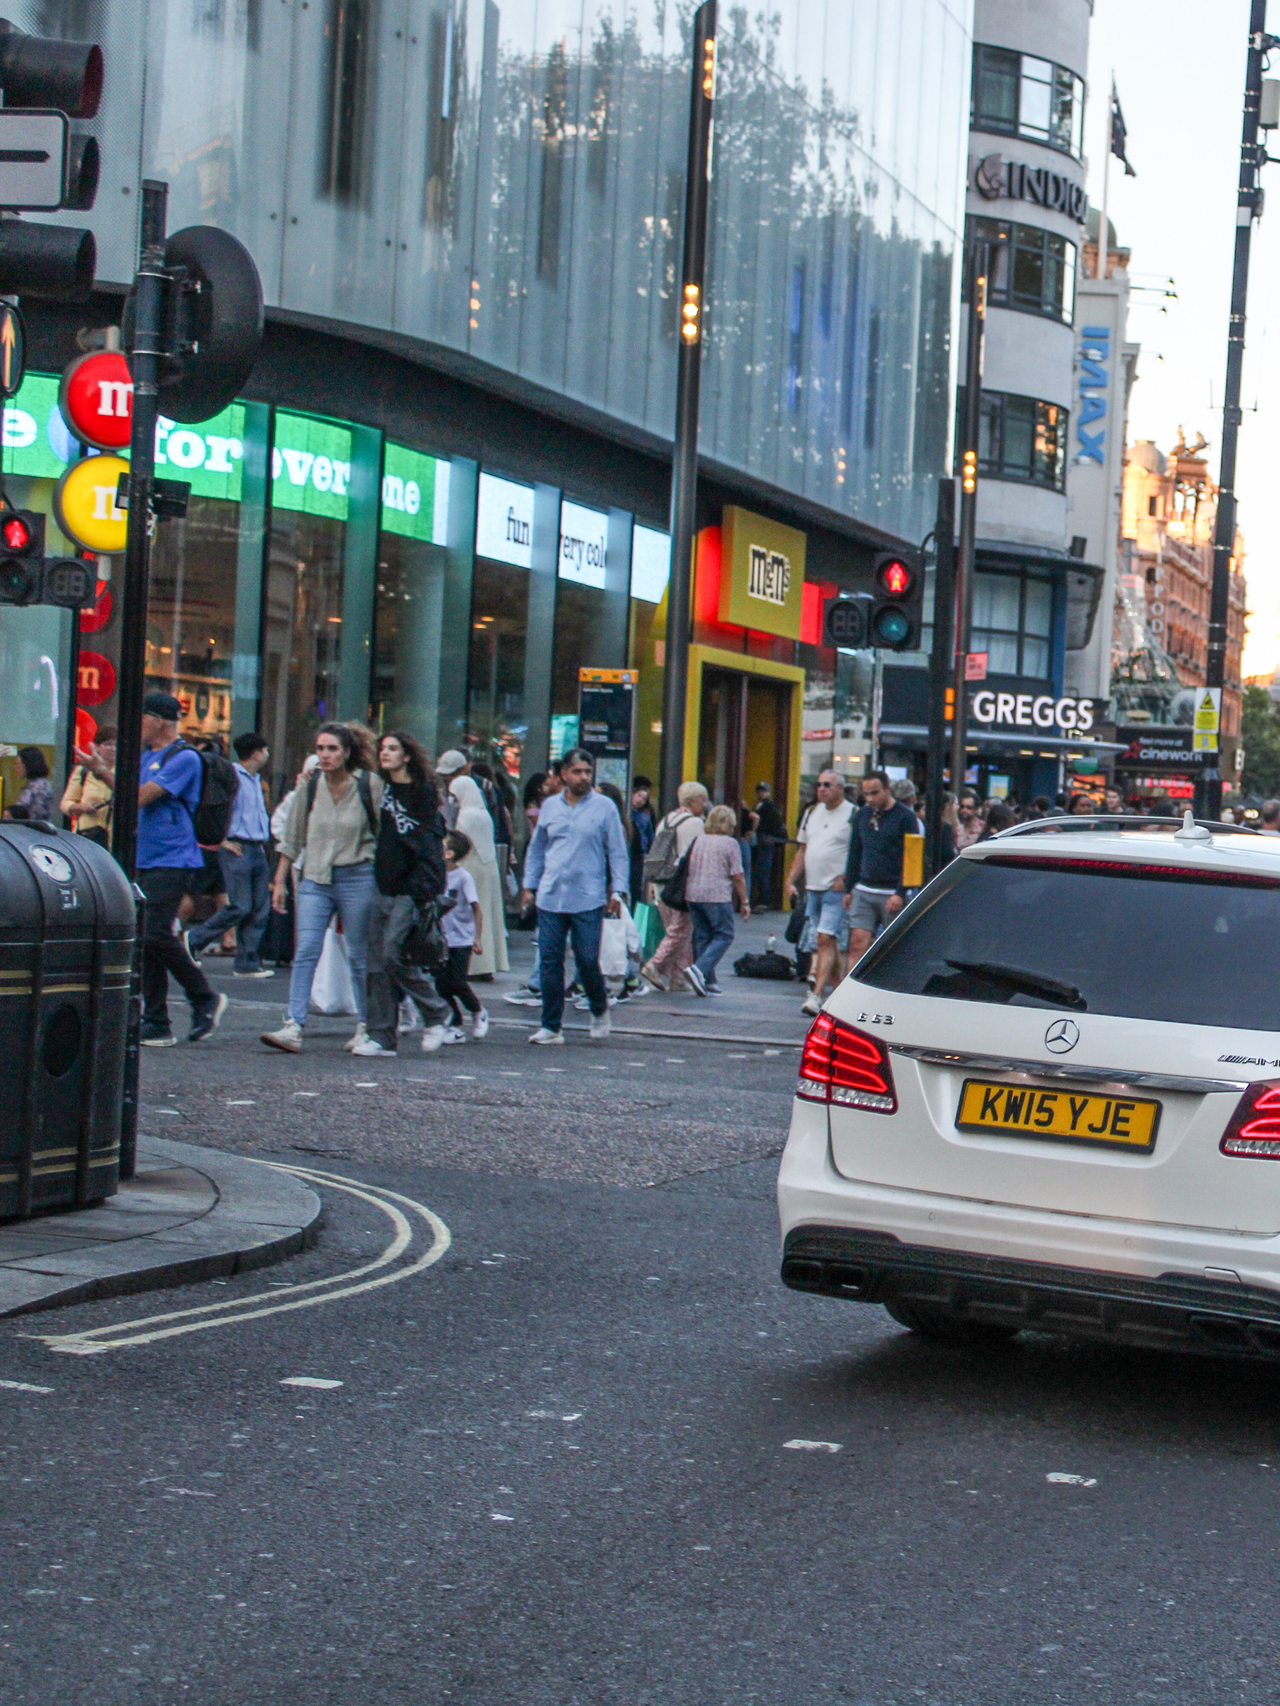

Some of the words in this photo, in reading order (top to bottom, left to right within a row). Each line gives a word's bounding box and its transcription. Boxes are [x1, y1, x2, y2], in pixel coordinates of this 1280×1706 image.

[1077, 326, 1111, 464] IMAX
[506, 506, 531, 546] fun
[973, 690, 1095, 730] GREGGS
[857, 1012, 868, 1022] E
[980, 1087, 1059, 1127] KW15
[1069, 1097, 1135, 1137] YJE
